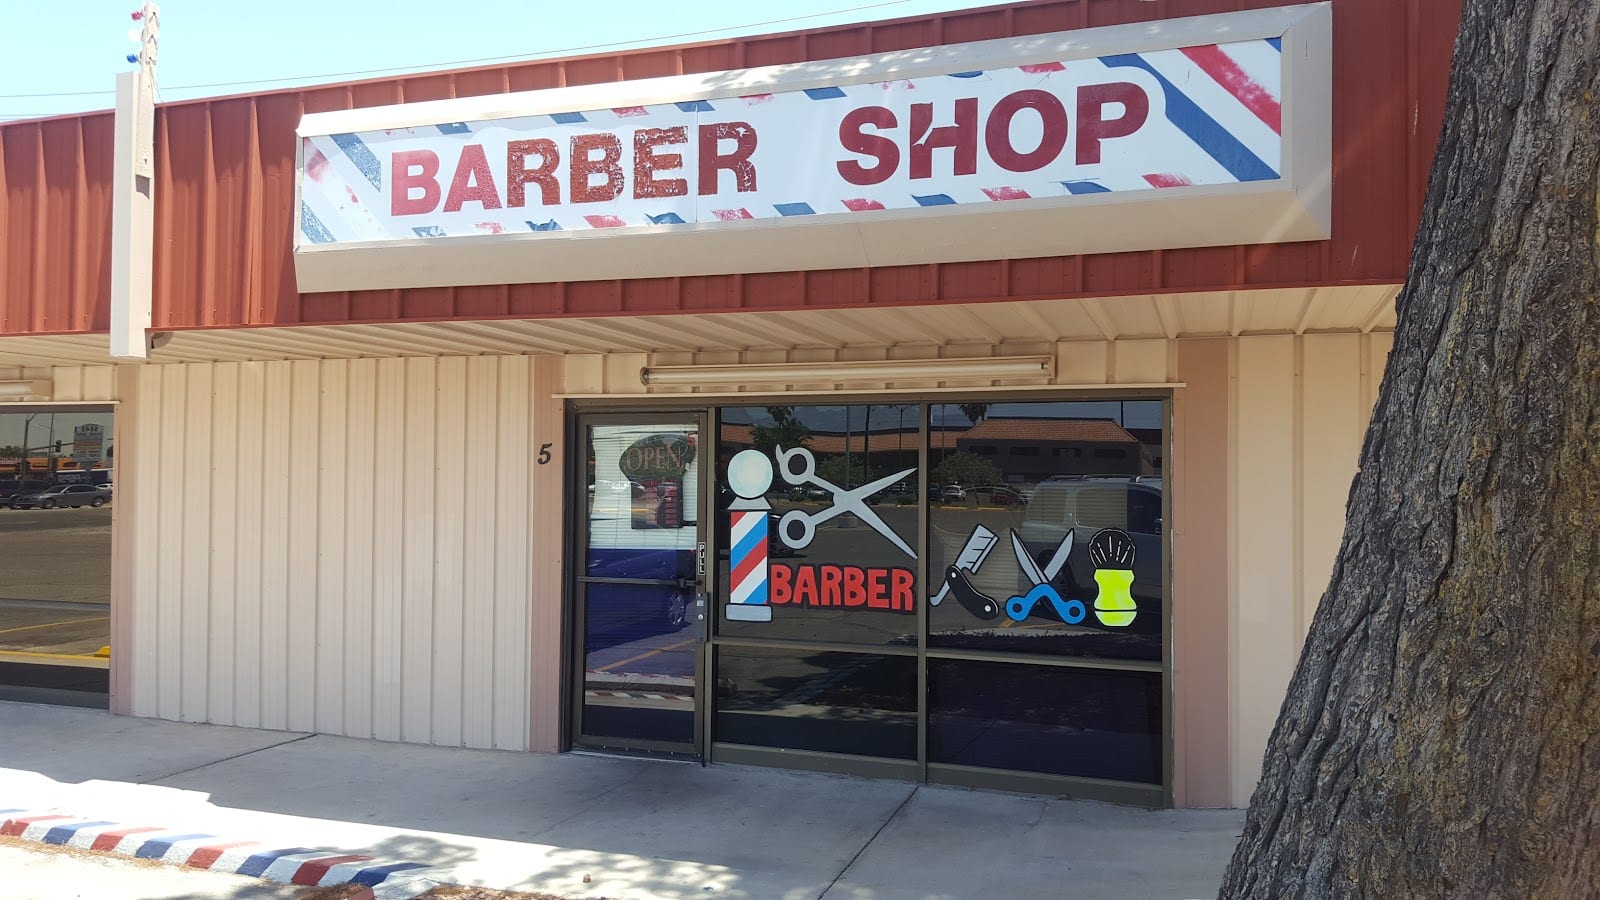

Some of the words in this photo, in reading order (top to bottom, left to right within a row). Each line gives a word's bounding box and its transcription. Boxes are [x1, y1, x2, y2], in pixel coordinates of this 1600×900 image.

[391, 121, 757, 216] BARBER
[837, 81, 1149, 186] SHOP
[537, 442, 553, 465] 5
[626, 443, 684, 470] OPEN
[769, 564, 914, 611] BARBER
